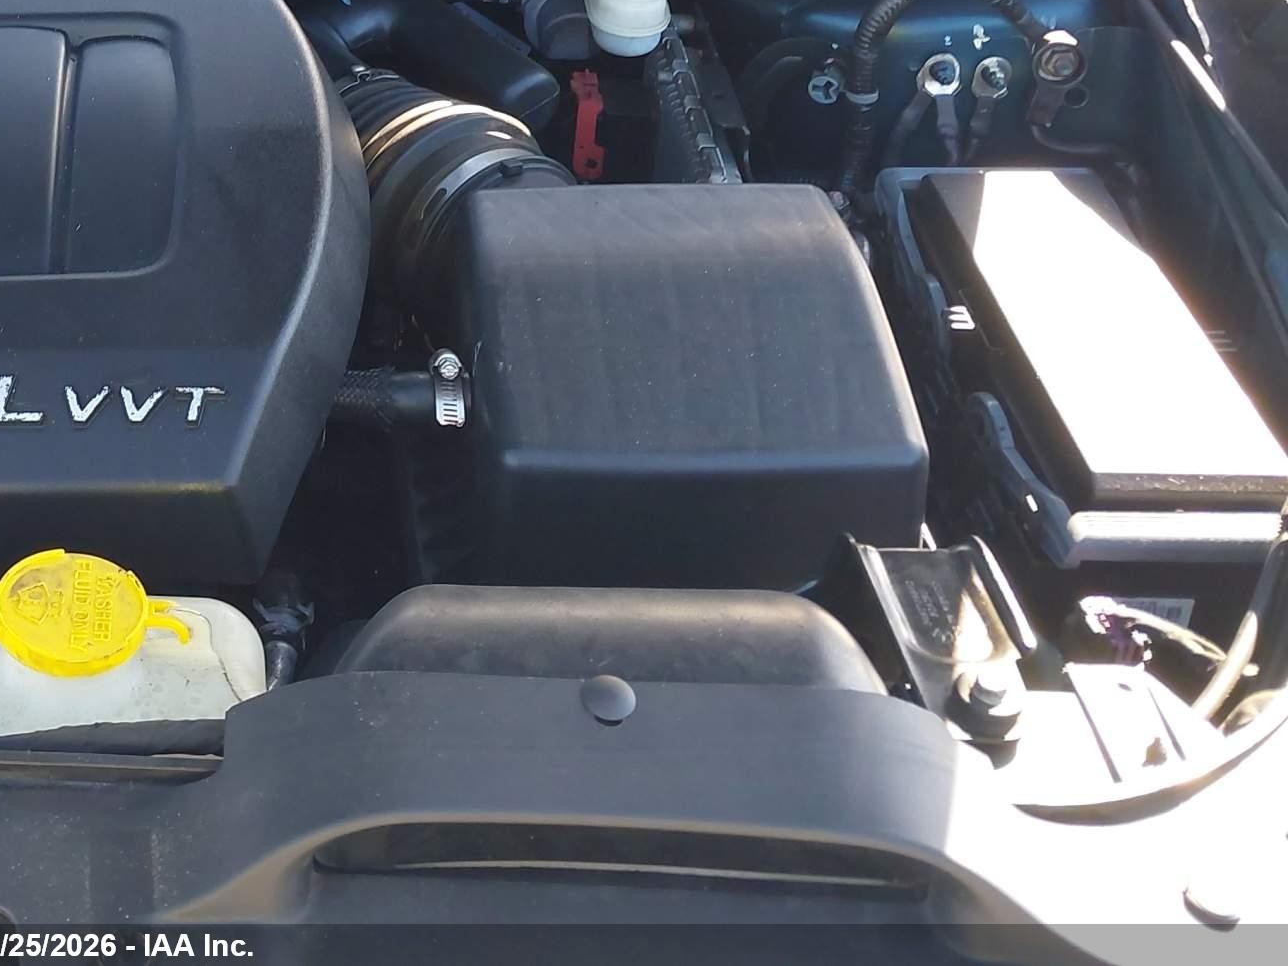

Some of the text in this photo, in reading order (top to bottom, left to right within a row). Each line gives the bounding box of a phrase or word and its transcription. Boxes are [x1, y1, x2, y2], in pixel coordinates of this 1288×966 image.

[64, 385, 226, 423] VVT
[69, 560, 93, 653] FLUID ONLY
[94, 575, 116, 642] WASHER
